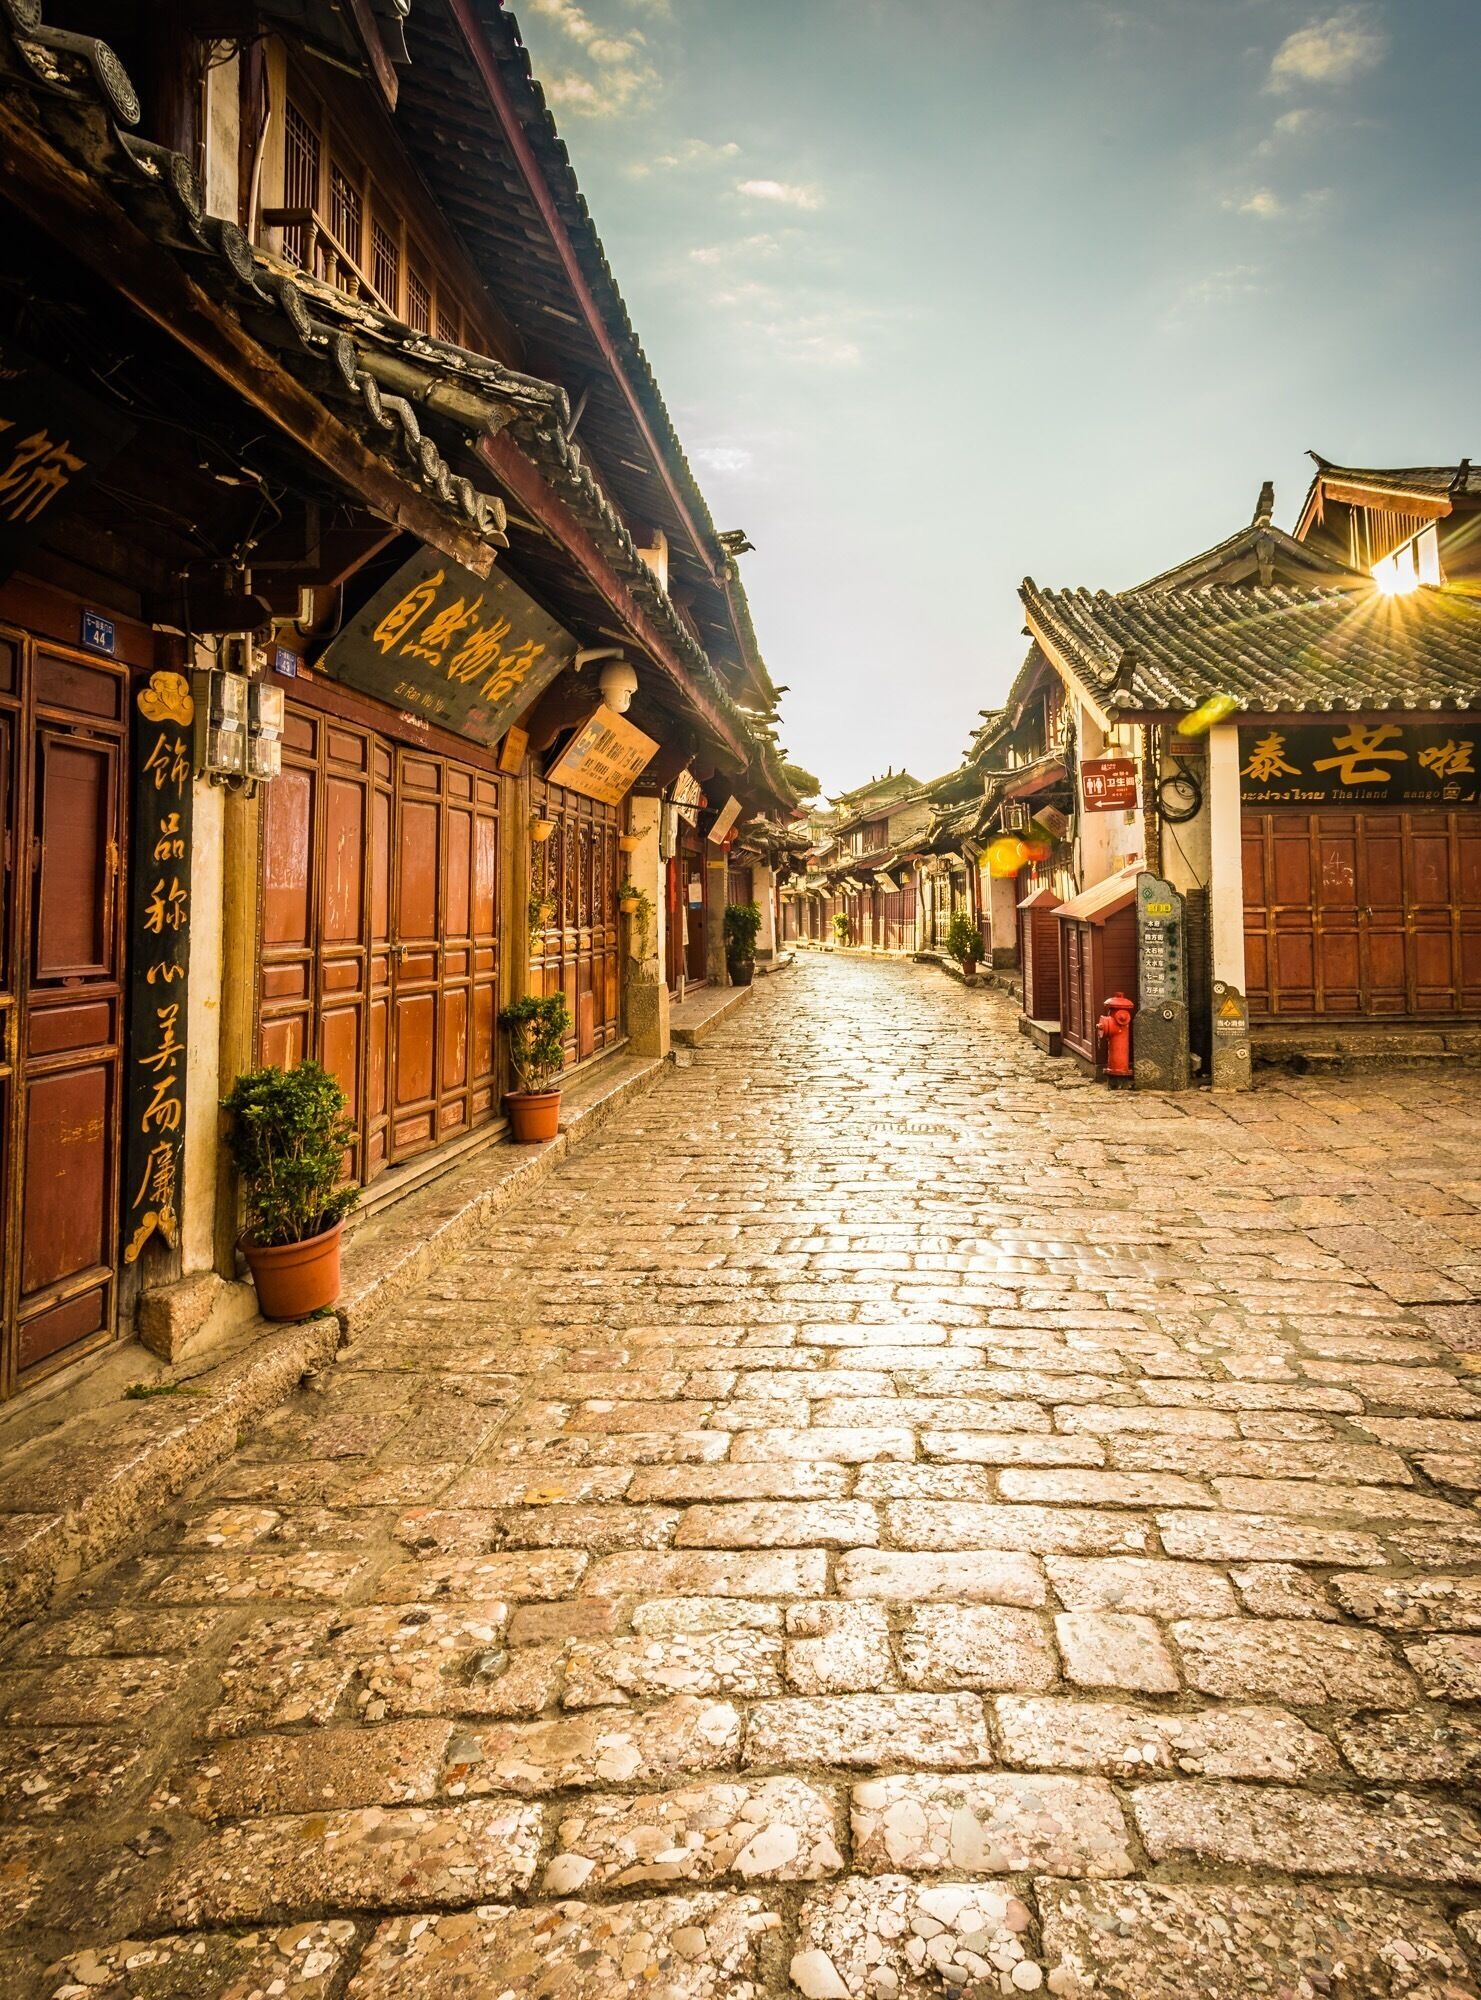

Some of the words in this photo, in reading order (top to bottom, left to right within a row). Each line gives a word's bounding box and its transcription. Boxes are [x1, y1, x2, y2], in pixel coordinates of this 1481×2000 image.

[93, 630, 106, 646] 44
[373, 569, 546, 701] 自然物语
[394, 681, 408, 694] Zi
[403, 687, 421, 702] Ran
[421, 694, 434, 708] Wu
[434, 699, 446, 713] Yu
[1331, 789, 1388, 800] Thailand
[1403, 791, 1440, 800] mango
[1329, 850, 1345, 869] 4
